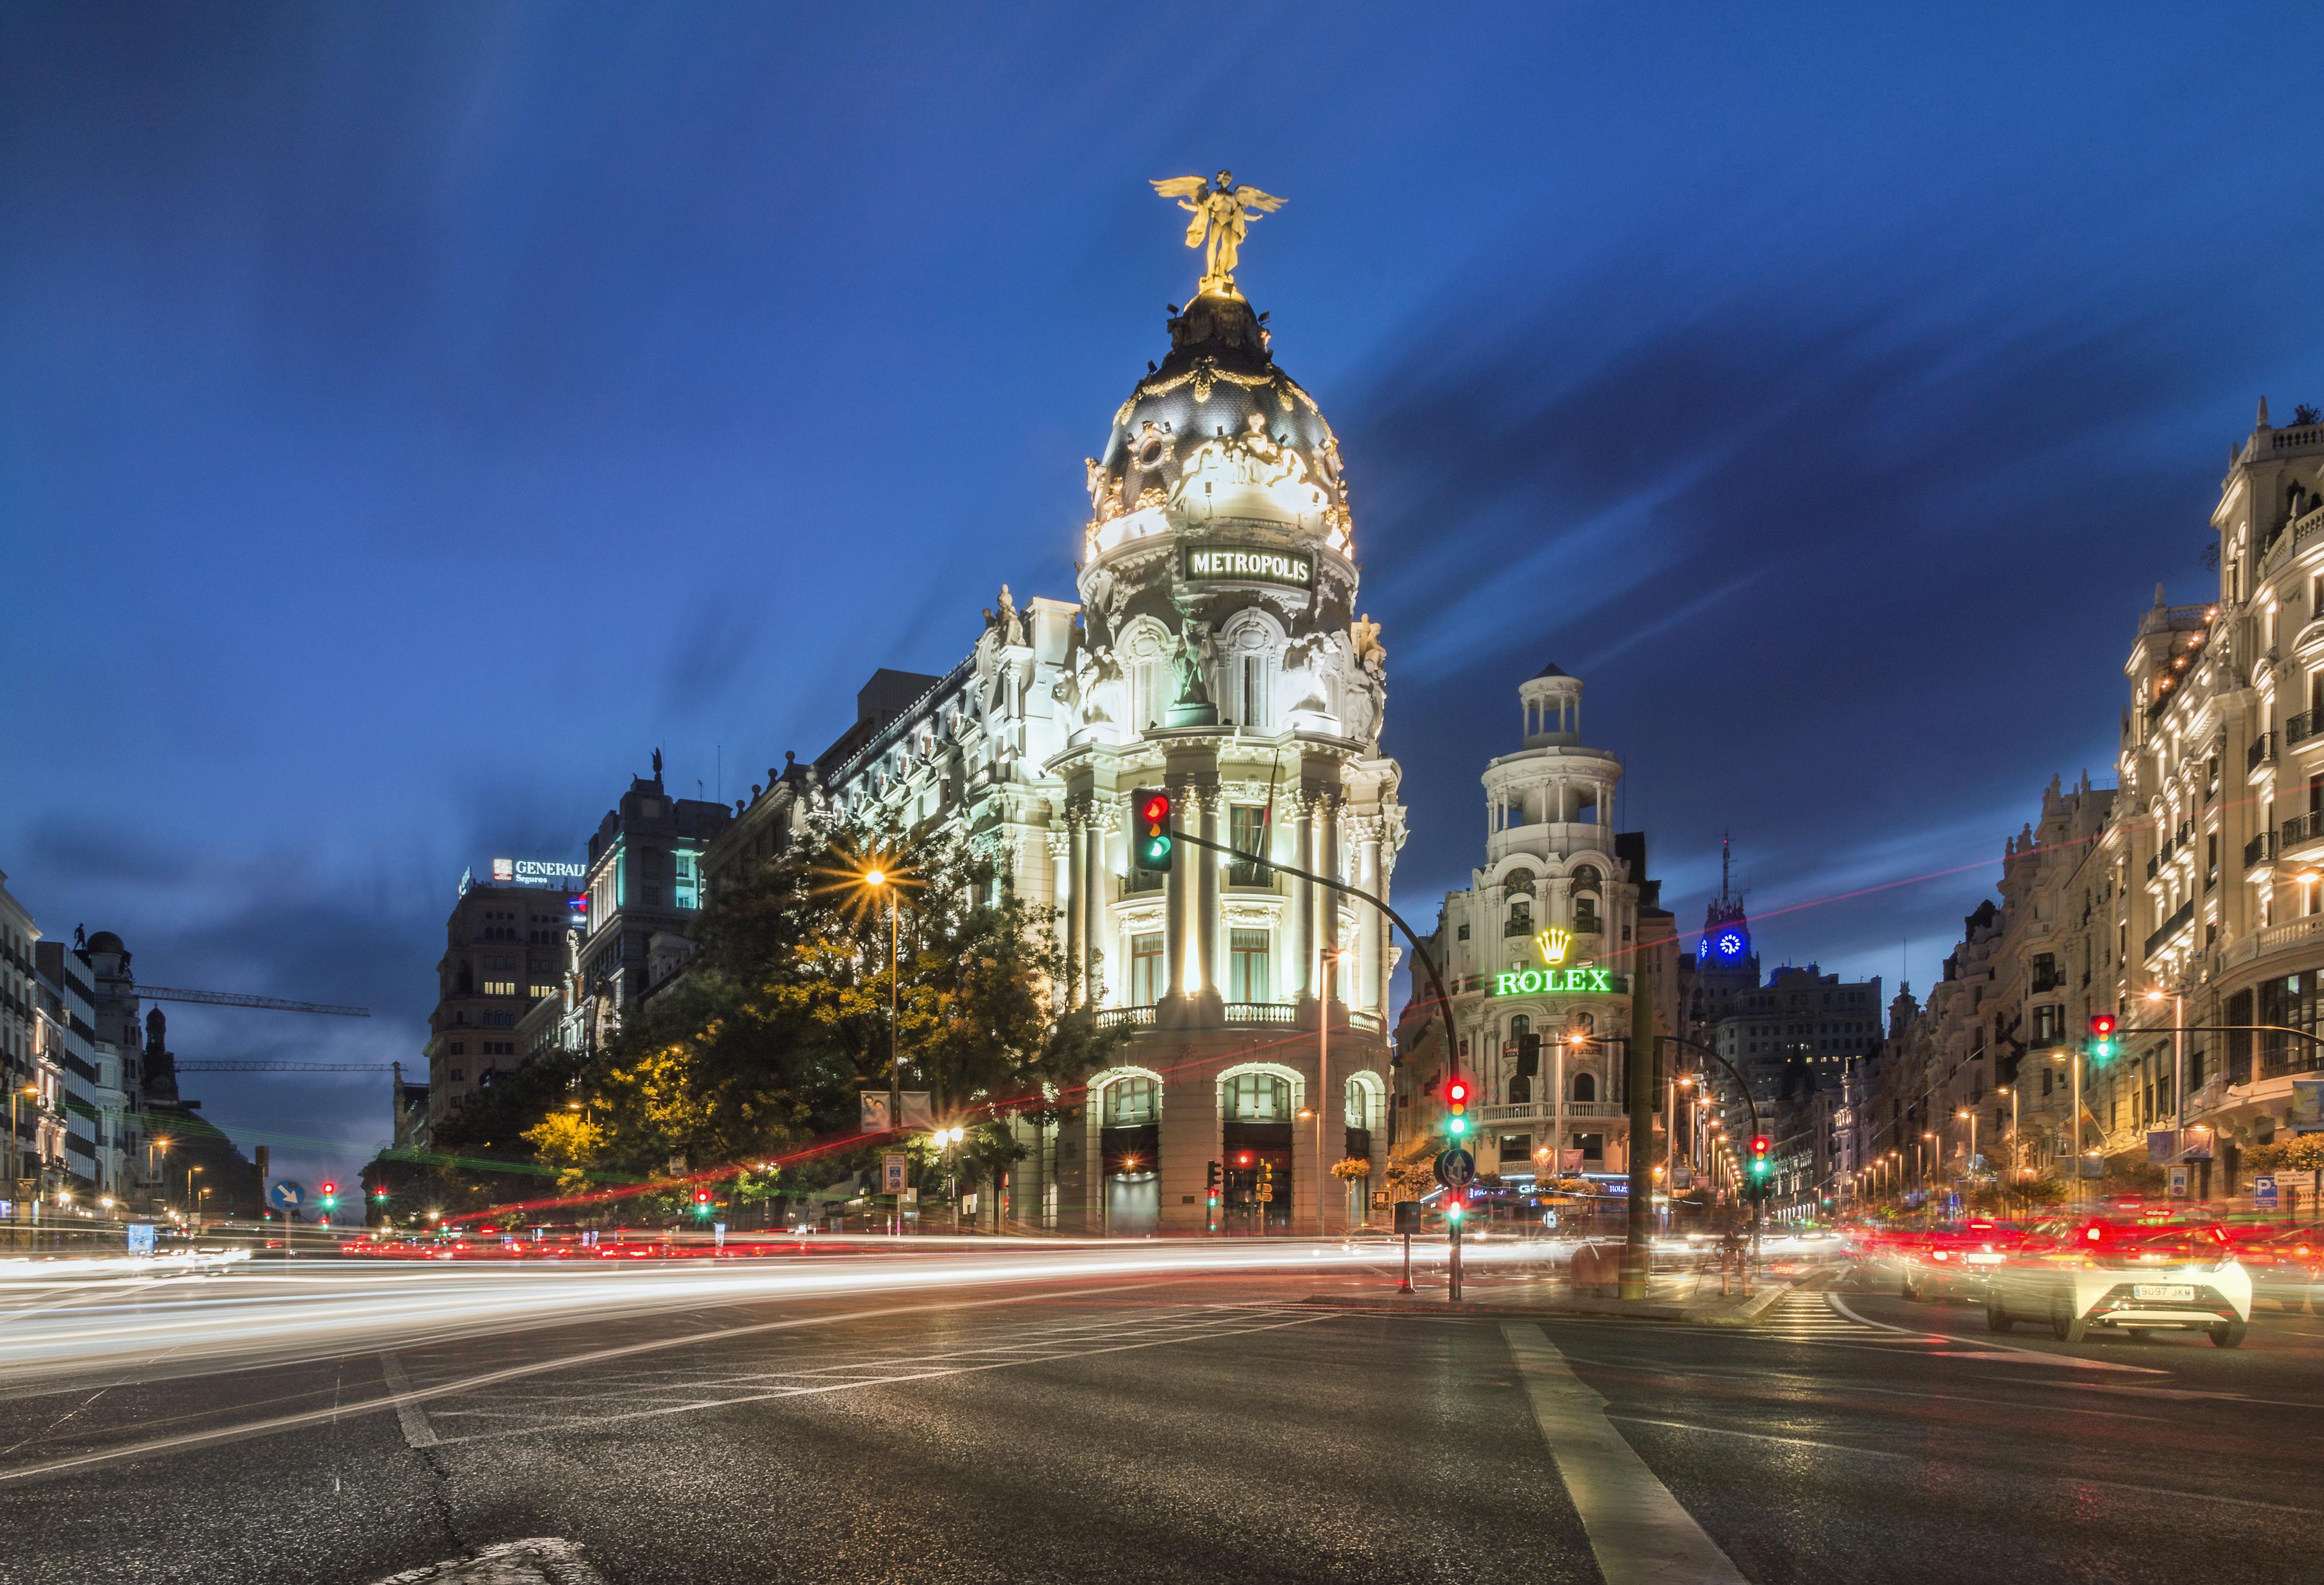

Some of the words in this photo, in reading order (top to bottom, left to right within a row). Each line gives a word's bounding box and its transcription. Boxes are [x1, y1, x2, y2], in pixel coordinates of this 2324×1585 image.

[1194, 553, 1309, 581] METROPOLIS
[517, 861, 586, 876] GENERALI
[516, 874, 548, 884] Seguros
[1496, 969, 1611, 996] ROLEX
[2257, 1179, 2271, 1195] P
[2141, 1287, 2167, 1295] 9097
[2171, 1288, 2191, 1296] JKM
